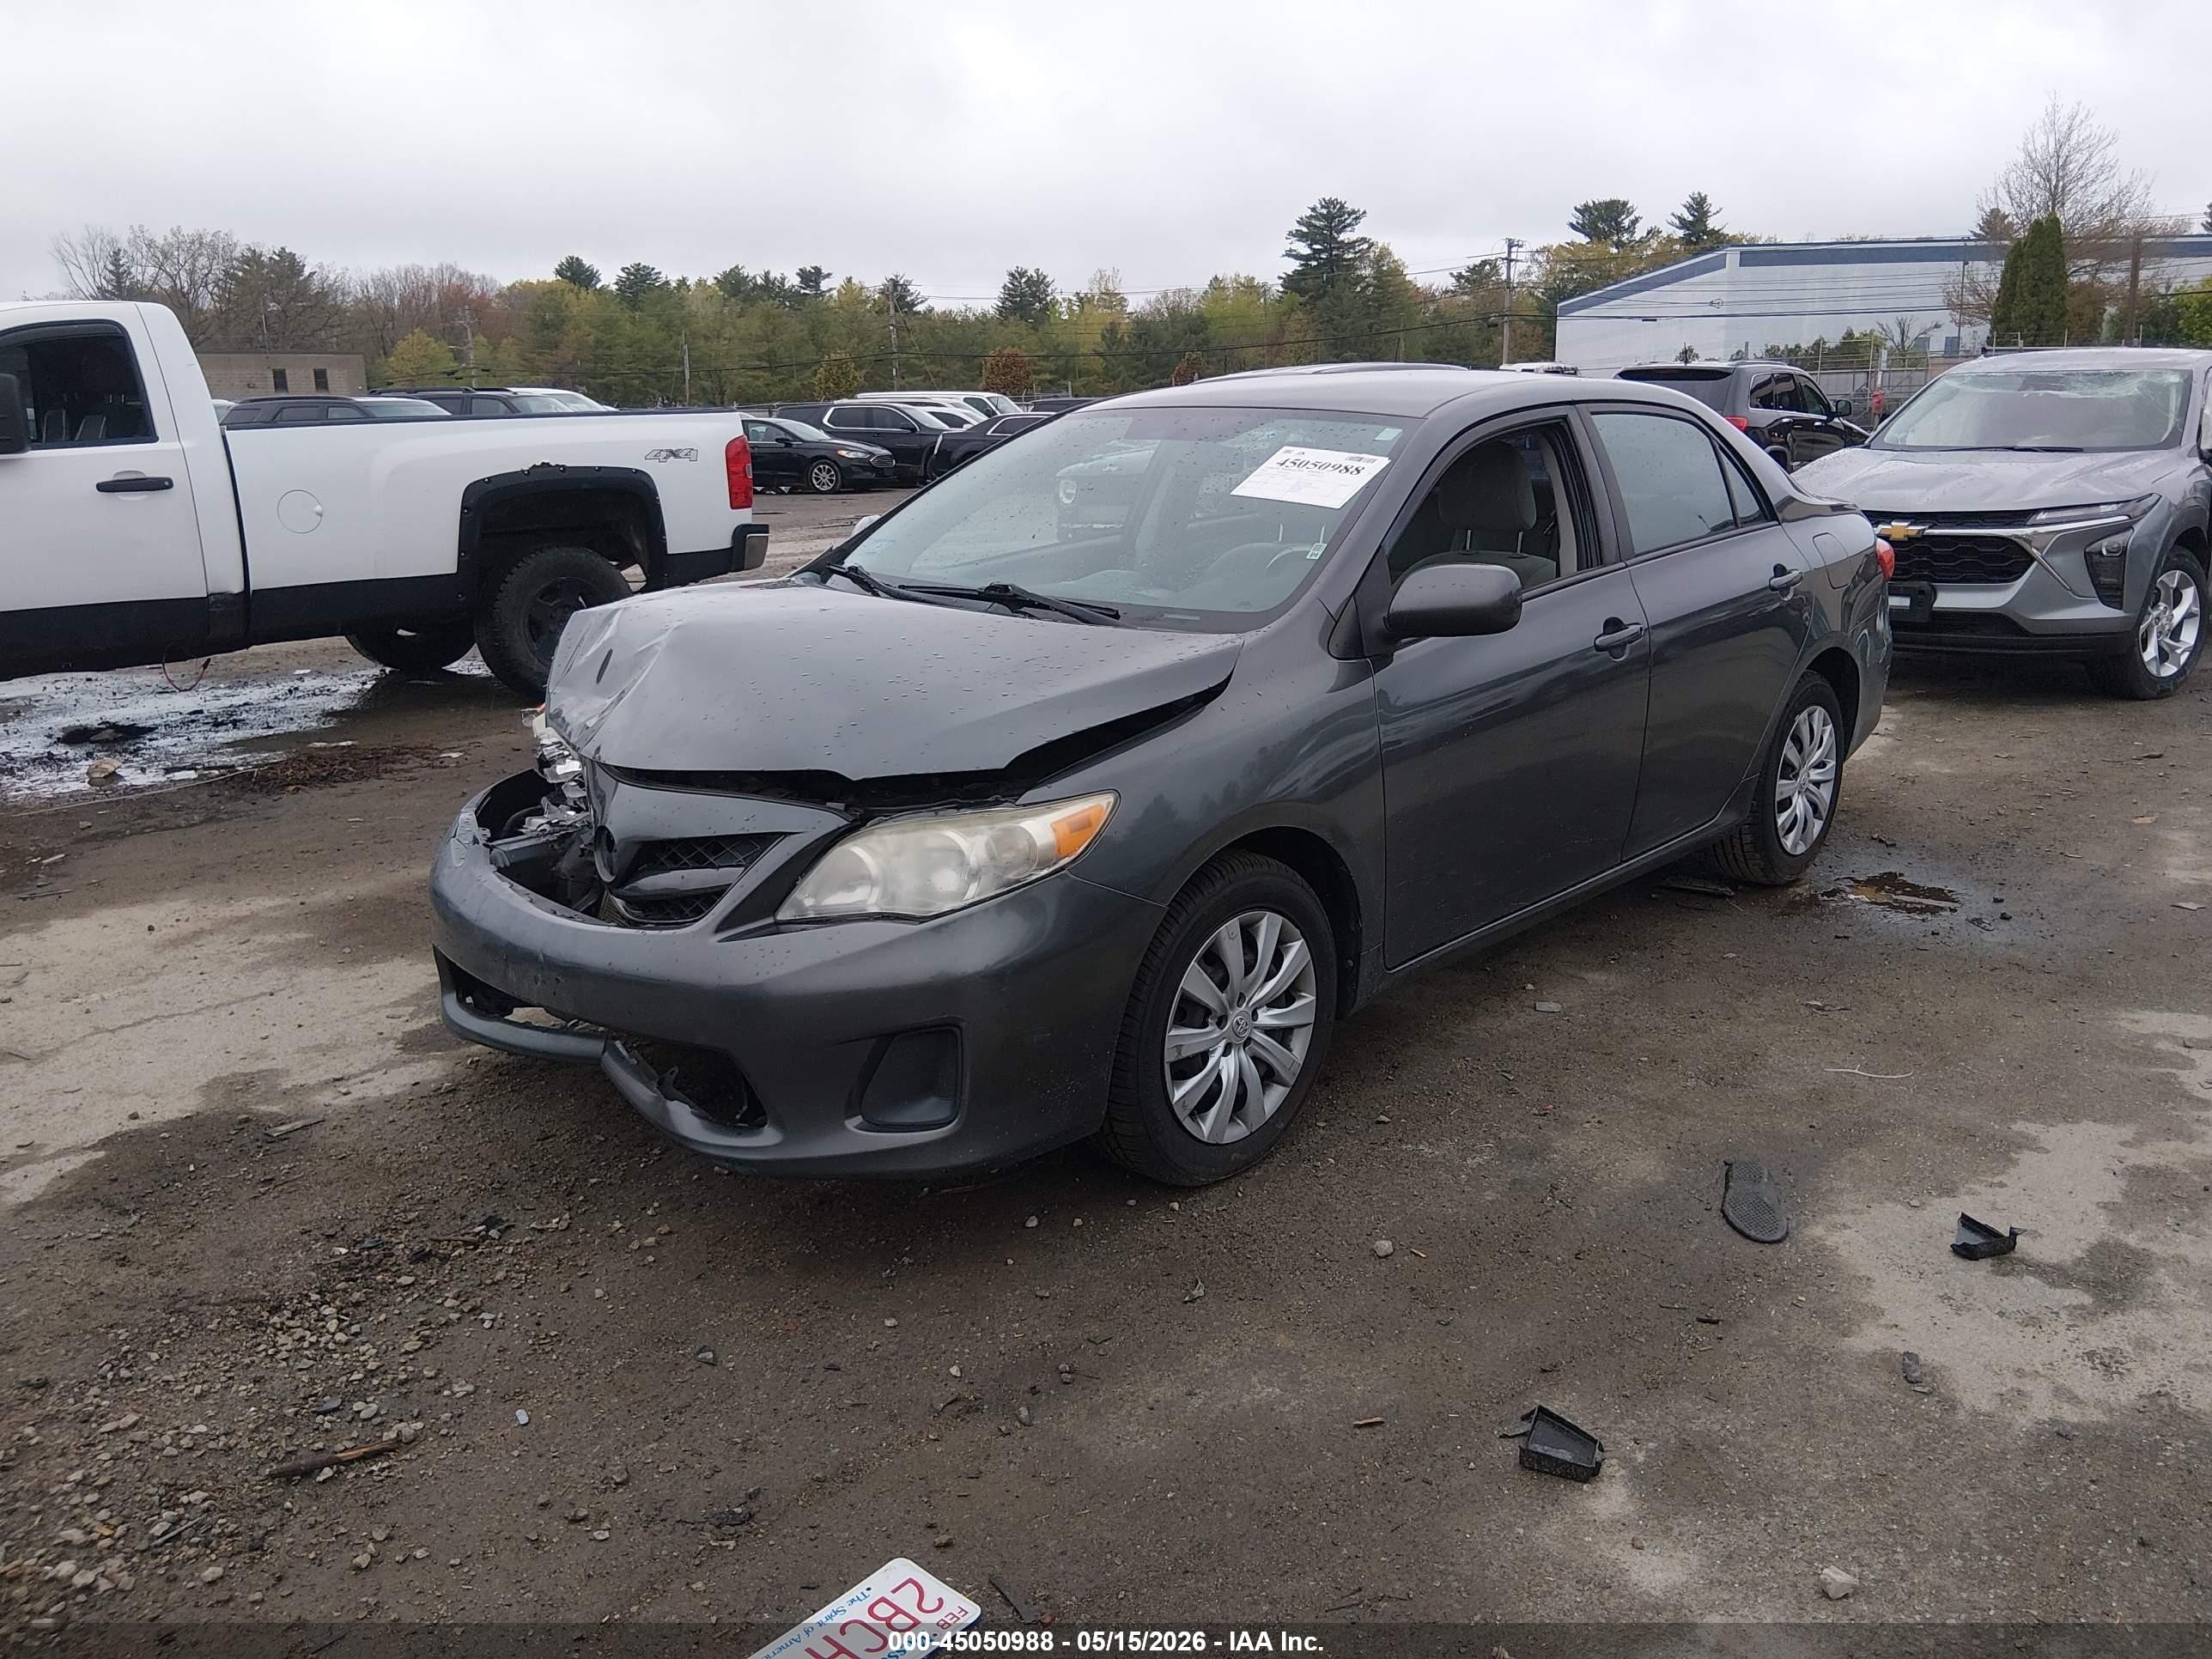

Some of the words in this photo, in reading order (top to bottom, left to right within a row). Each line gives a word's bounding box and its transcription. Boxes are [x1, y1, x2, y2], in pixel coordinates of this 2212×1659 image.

[1276, 458, 1365, 476] 45050988
[846, 1591, 870, 1607] The
[817, 1606, 847, 1627] Spirit
[937, 1606, 969, 1630] FEB
[804, 1626, 814, 1638] of
